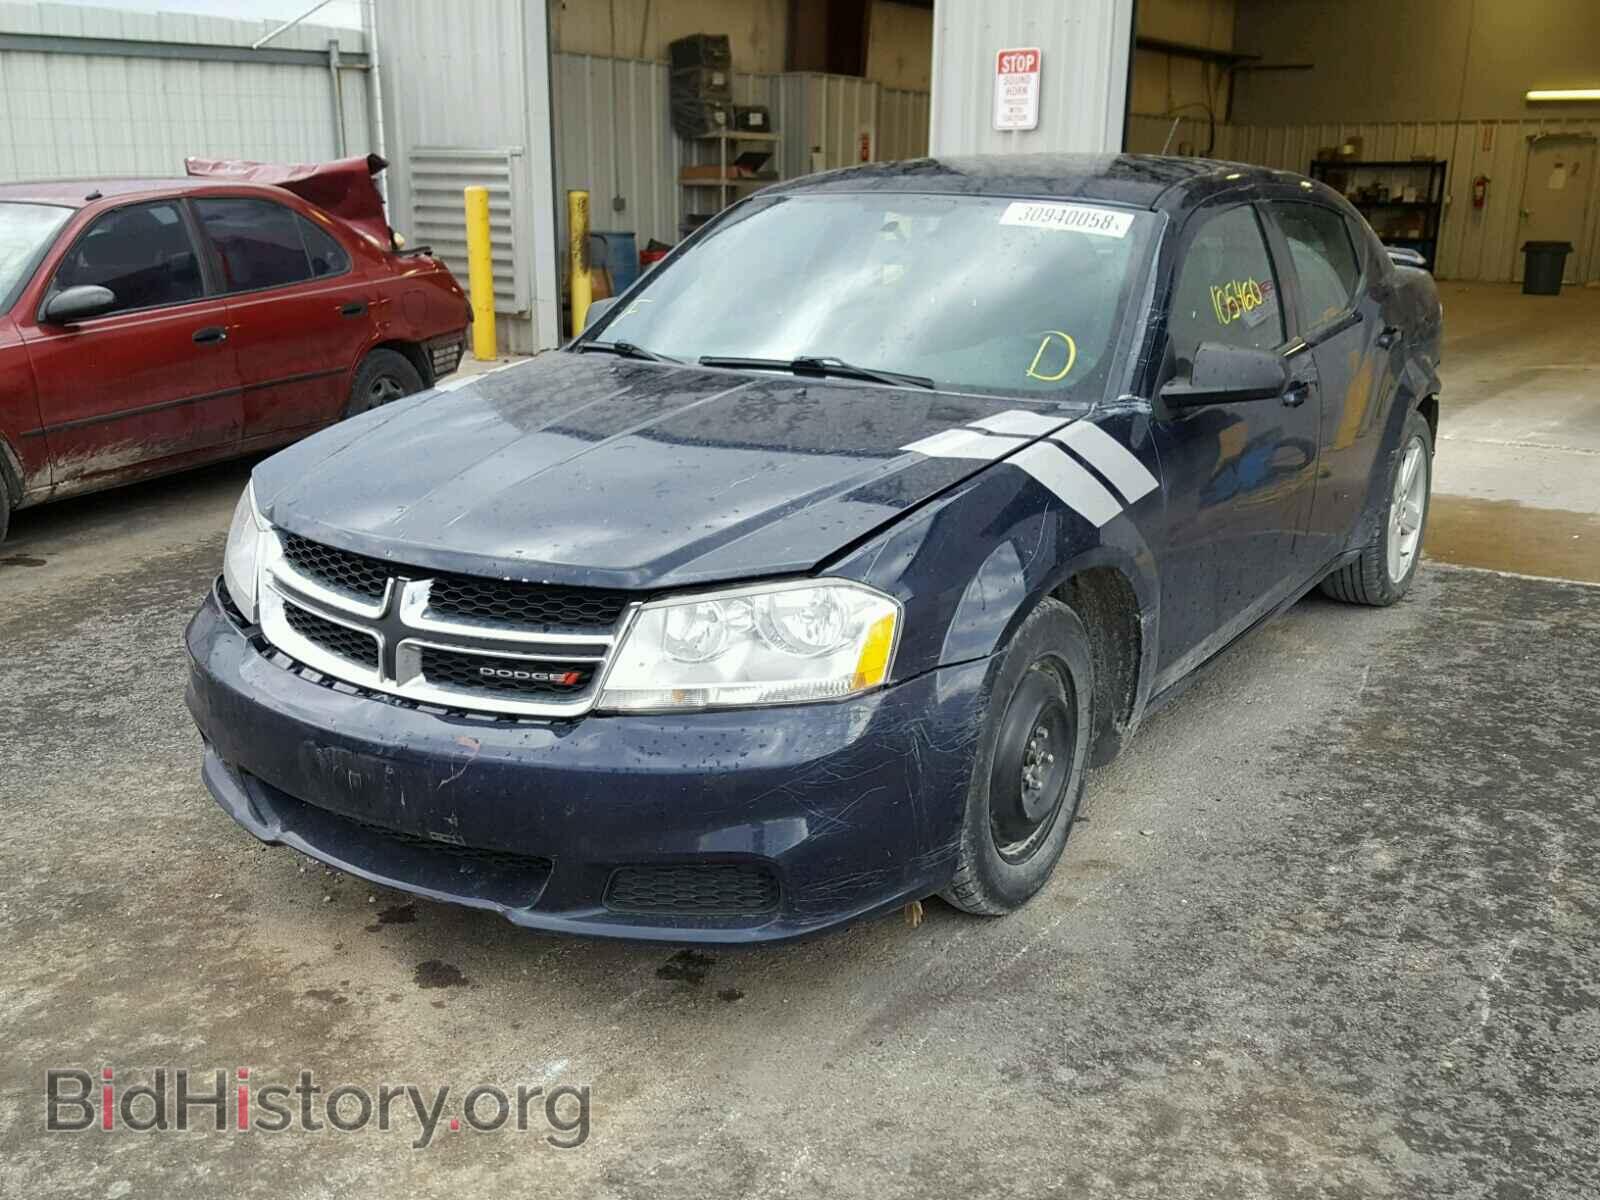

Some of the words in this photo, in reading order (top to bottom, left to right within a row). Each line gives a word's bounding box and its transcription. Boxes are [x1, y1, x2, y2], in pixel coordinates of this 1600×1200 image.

[1001, 55, 1035, 73] STOP
[1025, 330, 1077, 381] D
[479, 667, 567, 683] DODGE
